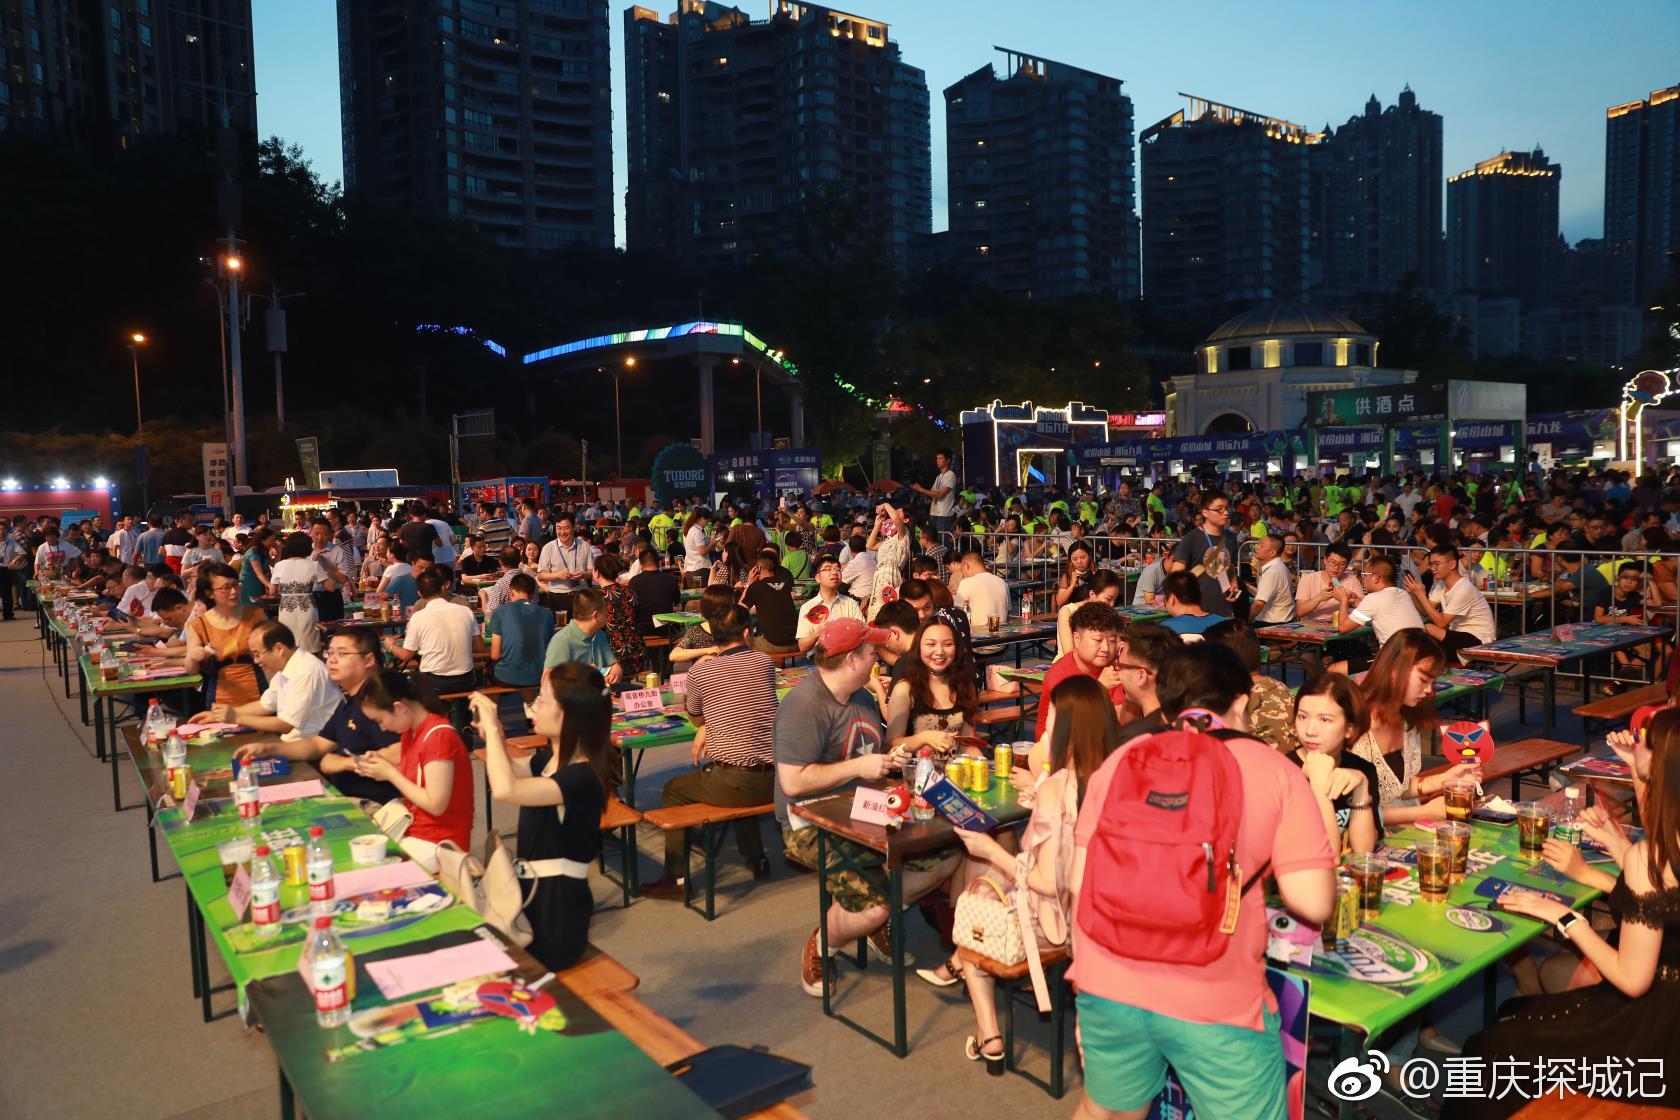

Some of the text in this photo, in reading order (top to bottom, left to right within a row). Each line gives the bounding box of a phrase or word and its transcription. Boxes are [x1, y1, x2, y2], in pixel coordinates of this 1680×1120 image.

[1355, 393, 1415, 415] 供酒点
[664, 469, 704, 481] TUBORG
[634, 700, 653, 709] 办公室
